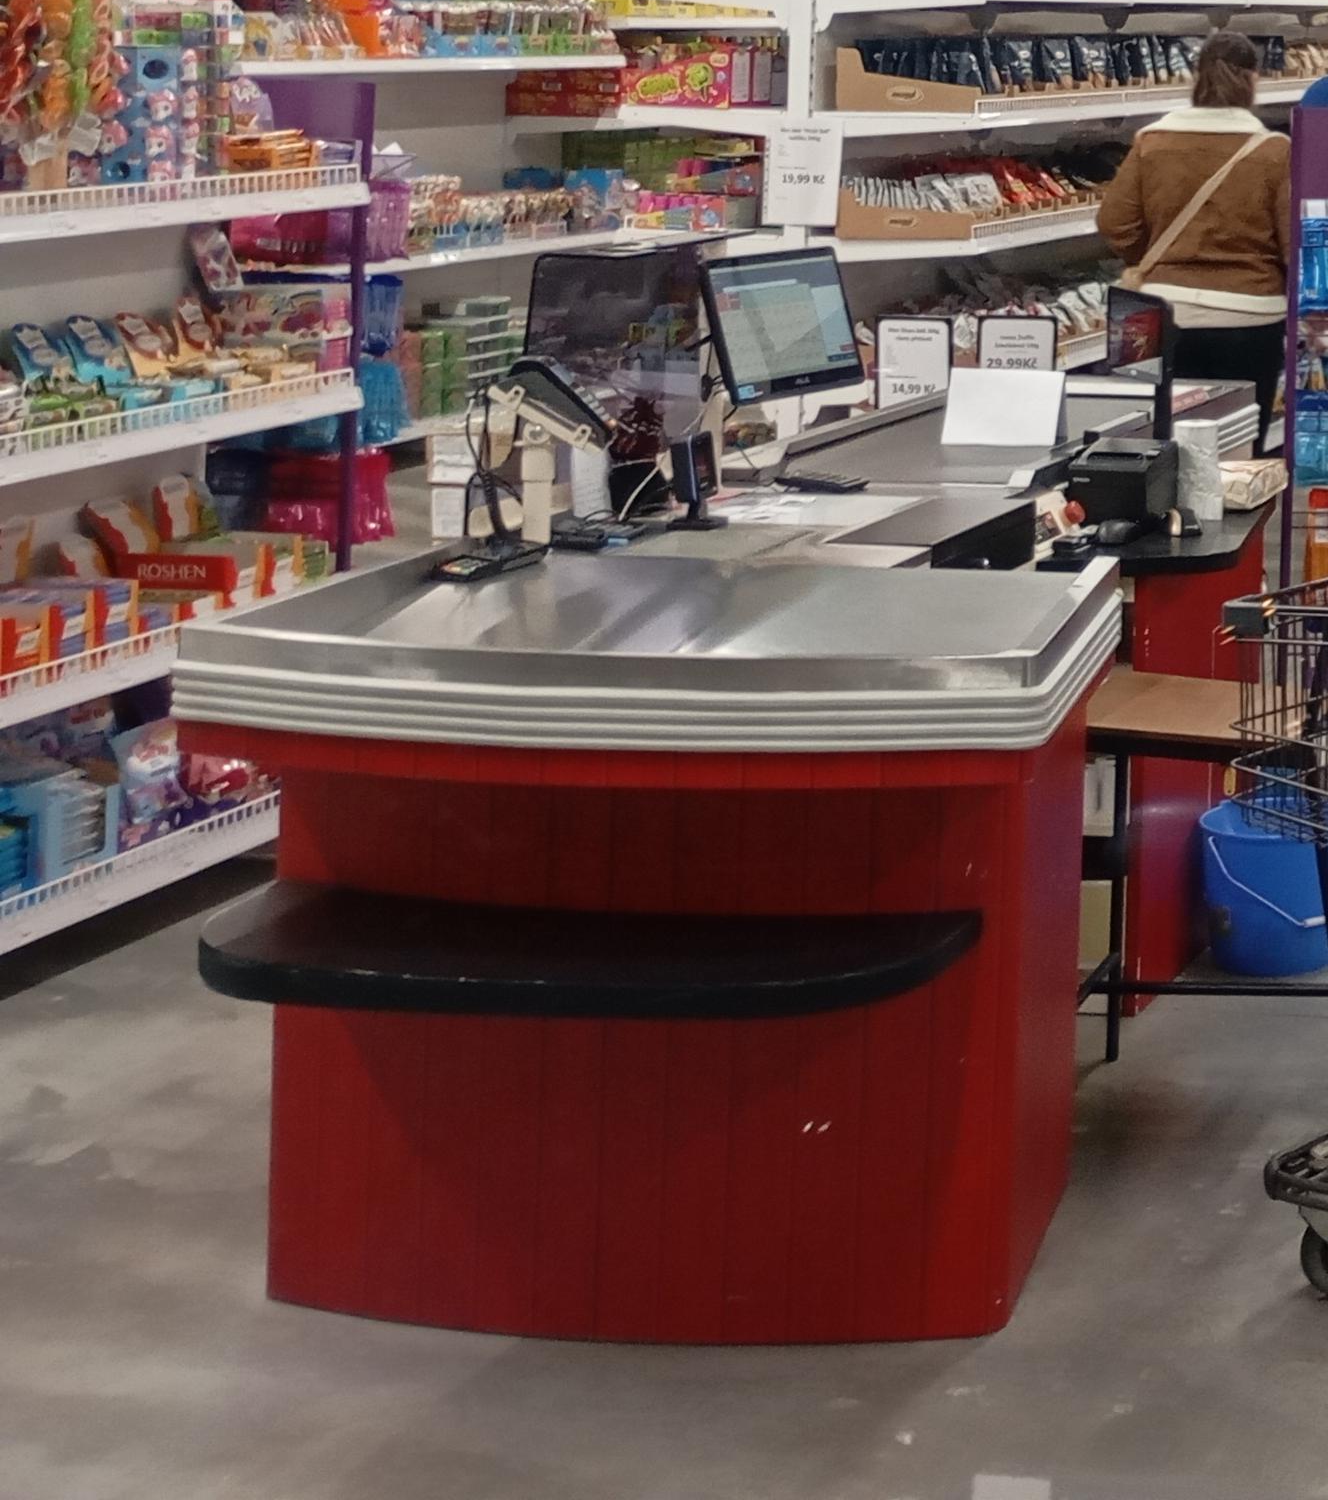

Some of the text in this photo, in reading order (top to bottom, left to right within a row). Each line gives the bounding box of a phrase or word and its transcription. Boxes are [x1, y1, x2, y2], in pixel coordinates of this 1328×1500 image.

[782, 173, 810, 185] 19,99
[892, 382, 921, 395] 14,99
[137, 563, 207, 579] ROSHEN
